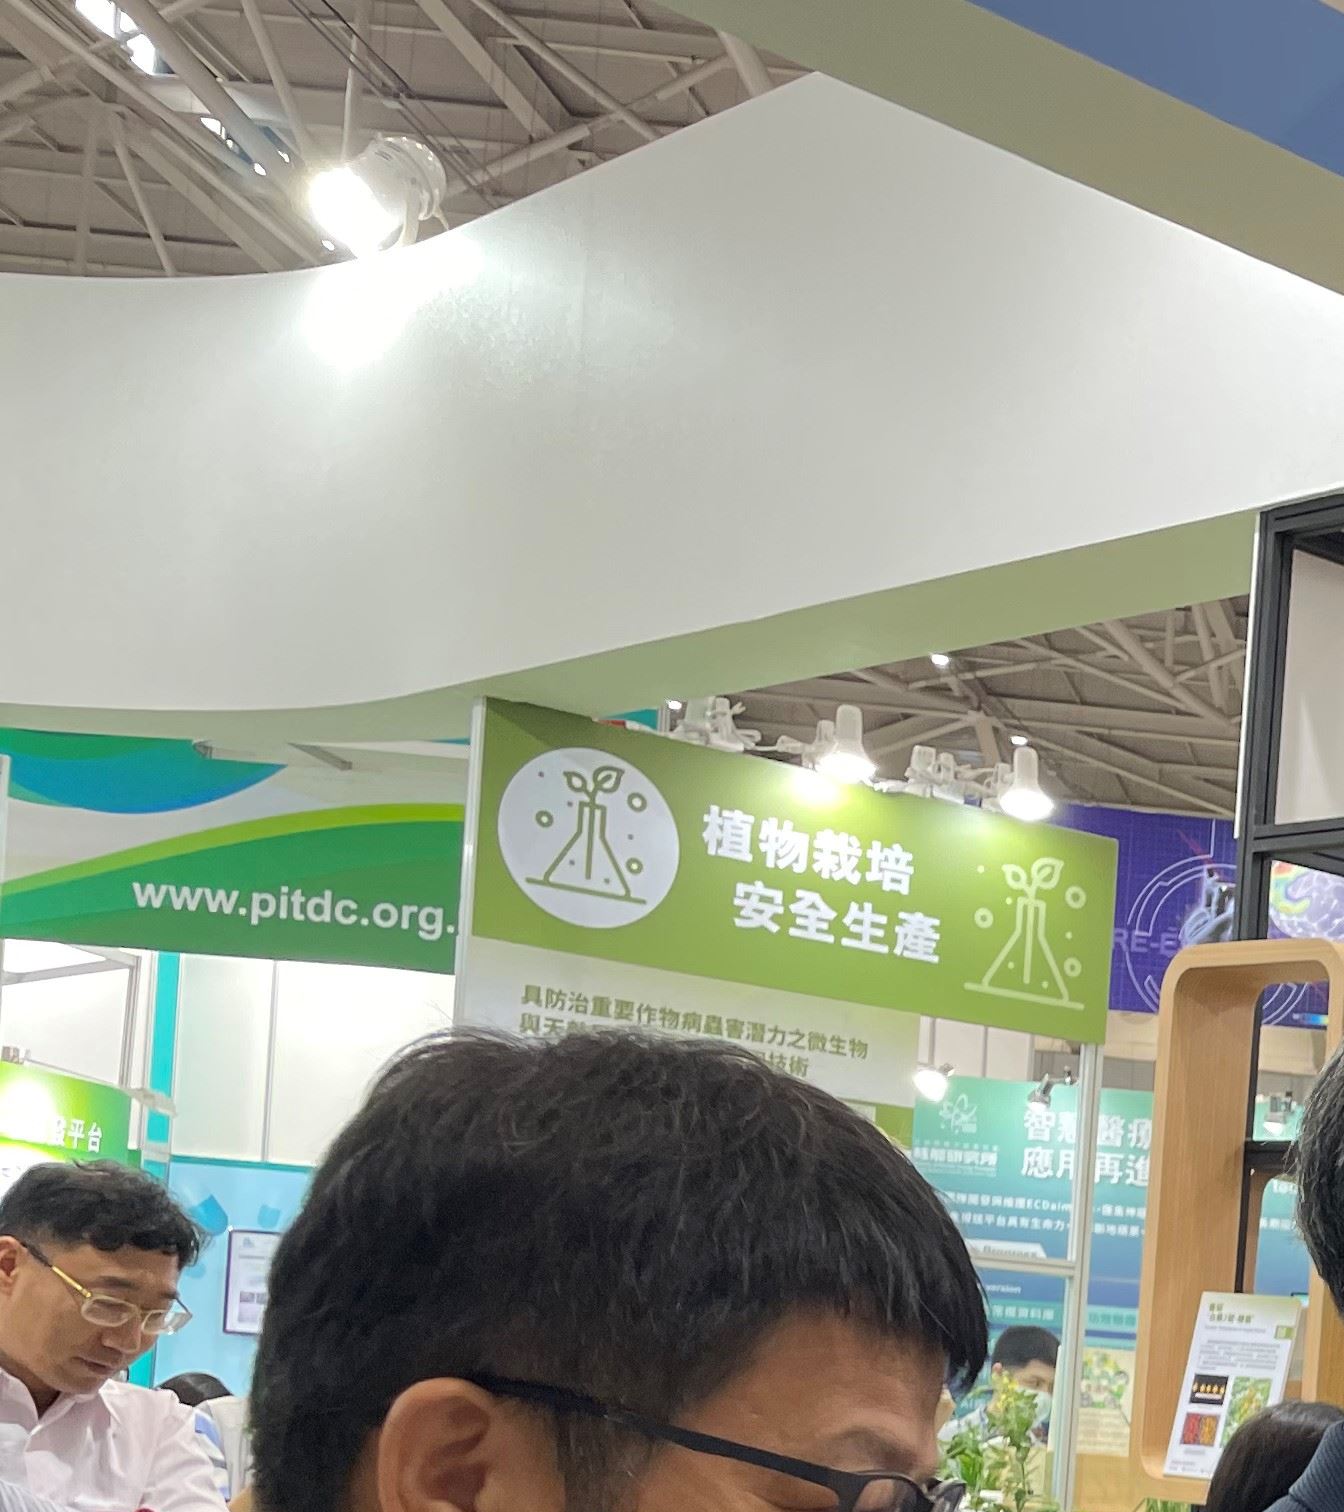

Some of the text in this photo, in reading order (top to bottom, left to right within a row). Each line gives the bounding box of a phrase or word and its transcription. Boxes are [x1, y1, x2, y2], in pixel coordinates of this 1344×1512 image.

[702, 804, 915, 896] 植物栽培
[732, 880, 941, 964] 安全生產
[521, 984, 868, 1060] 具防治重要作物病蟲害潛力之微生物
